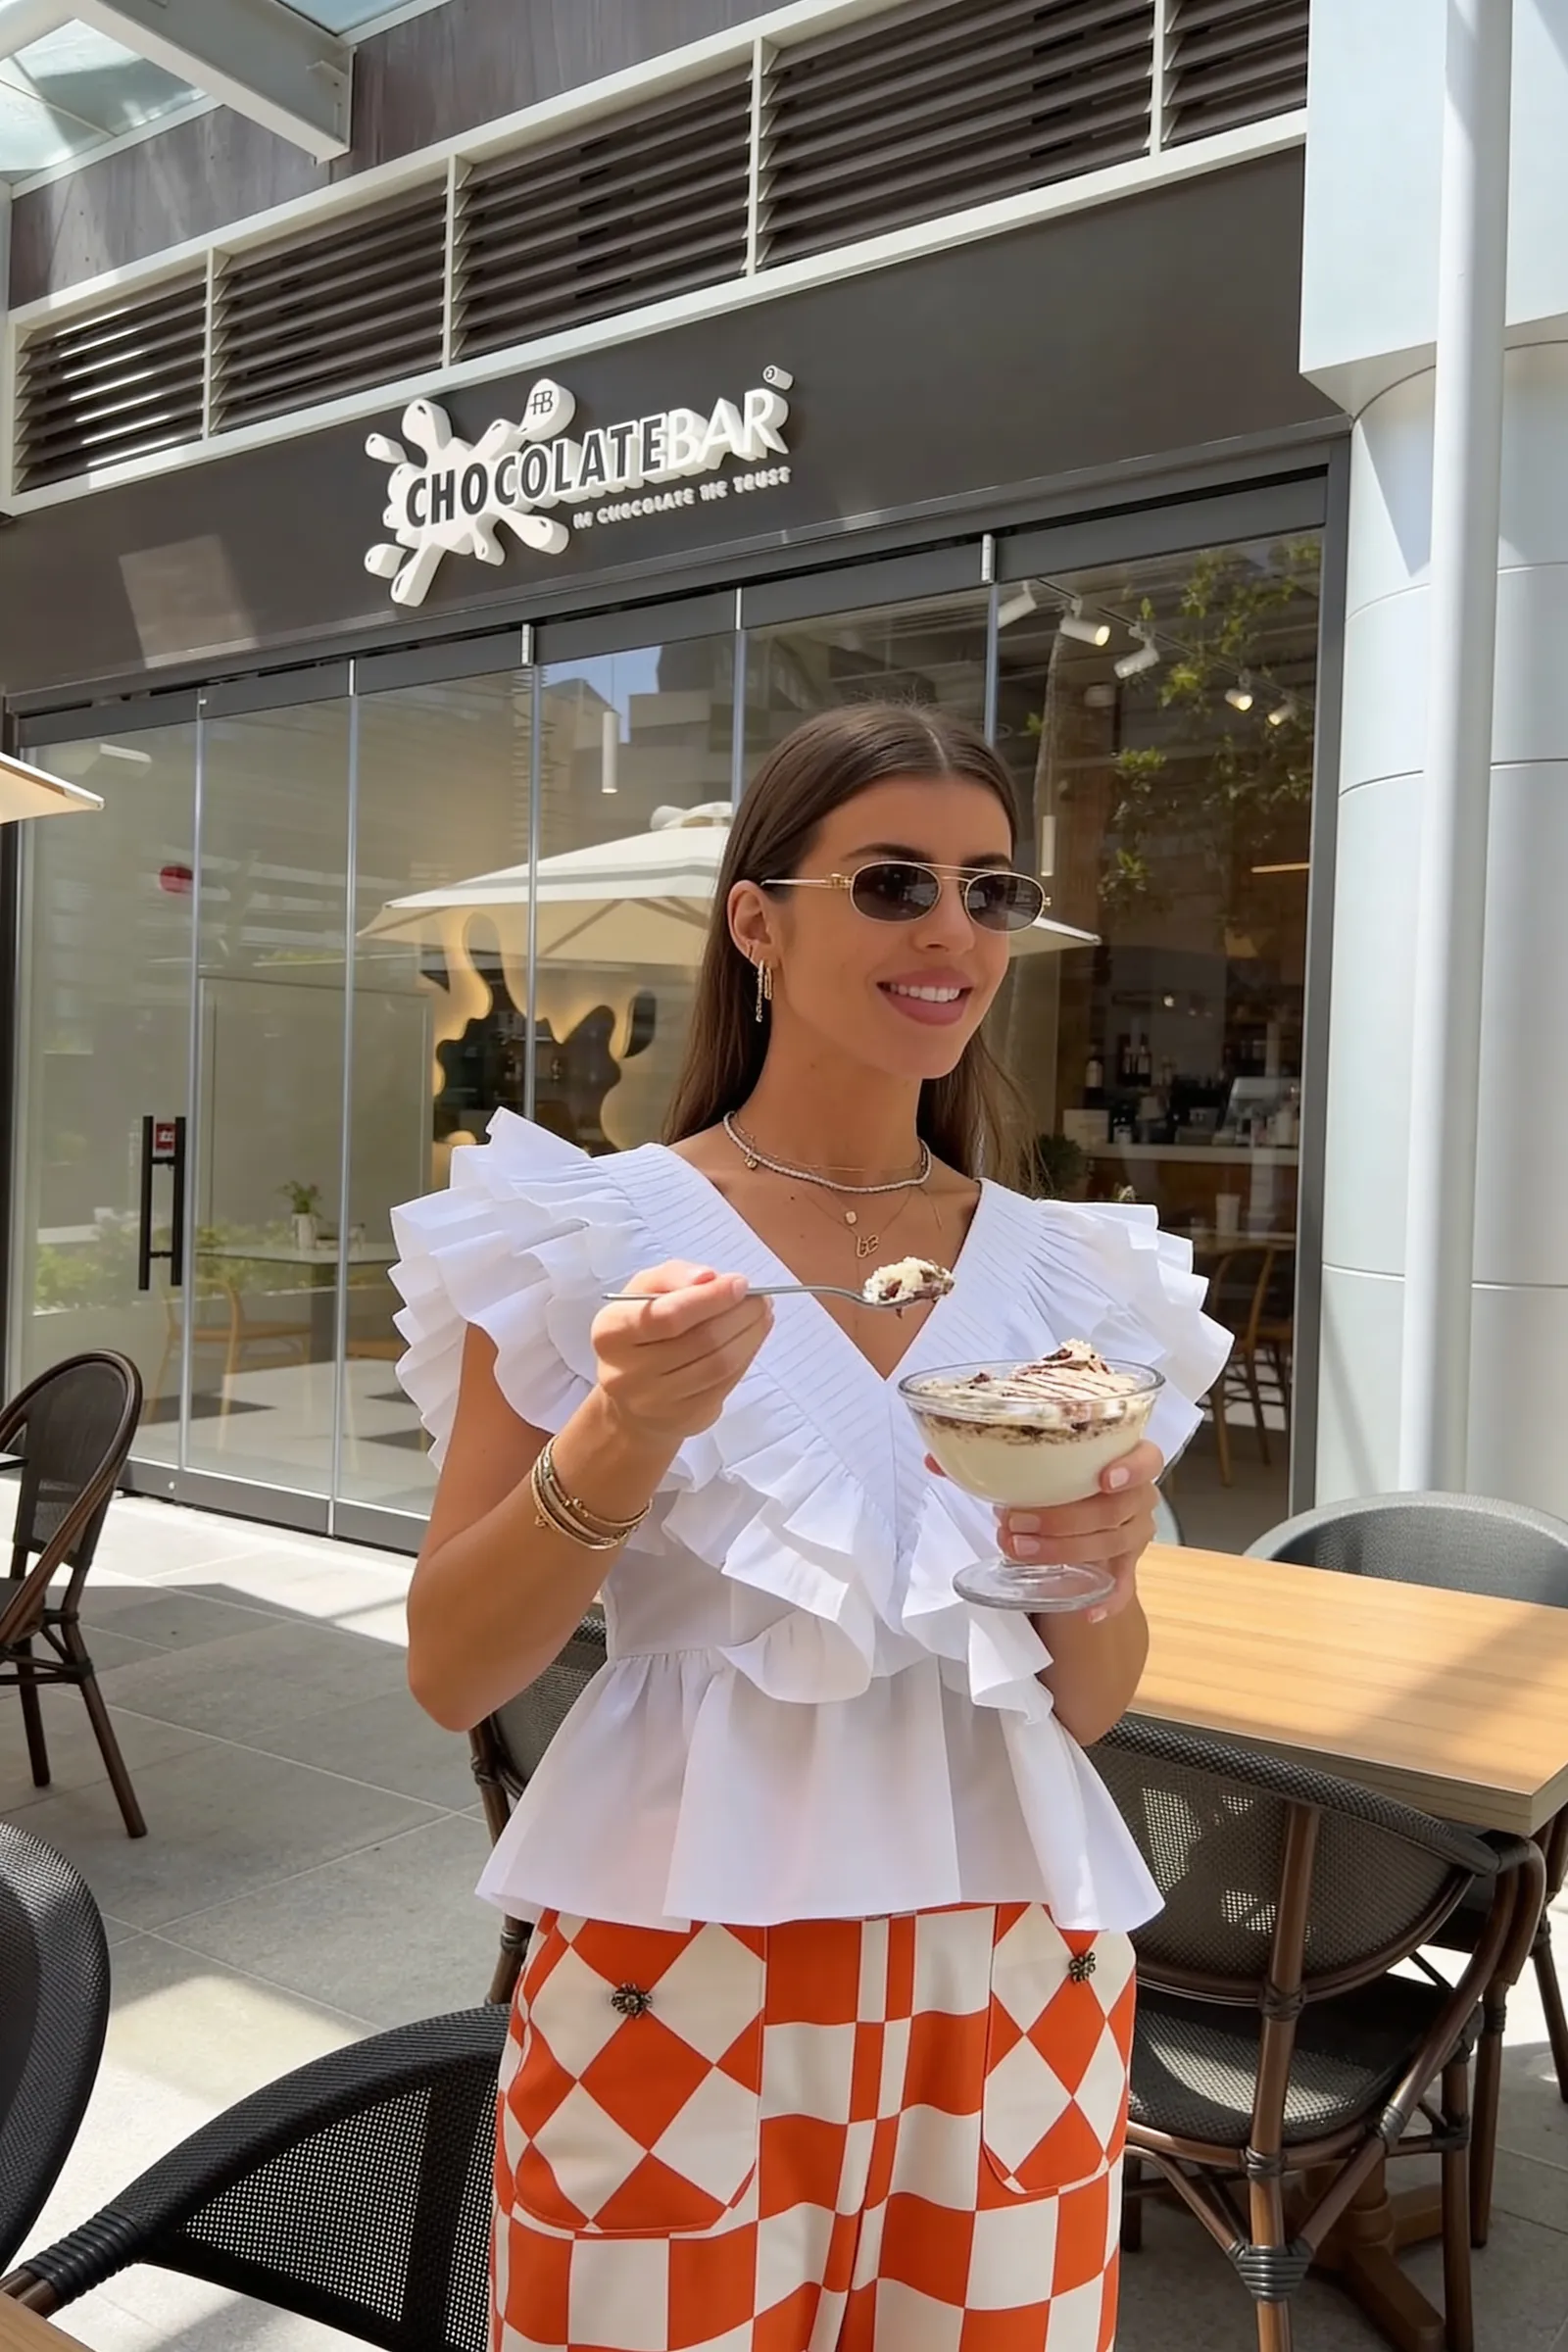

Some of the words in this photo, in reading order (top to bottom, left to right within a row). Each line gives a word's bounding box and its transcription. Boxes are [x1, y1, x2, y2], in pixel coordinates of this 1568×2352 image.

[404, 387, 790, 529] CHOCOLATEBAR
[596, 487, 695, 525] CHOCOLATE
[732, 466, 792, 495] TRUST
